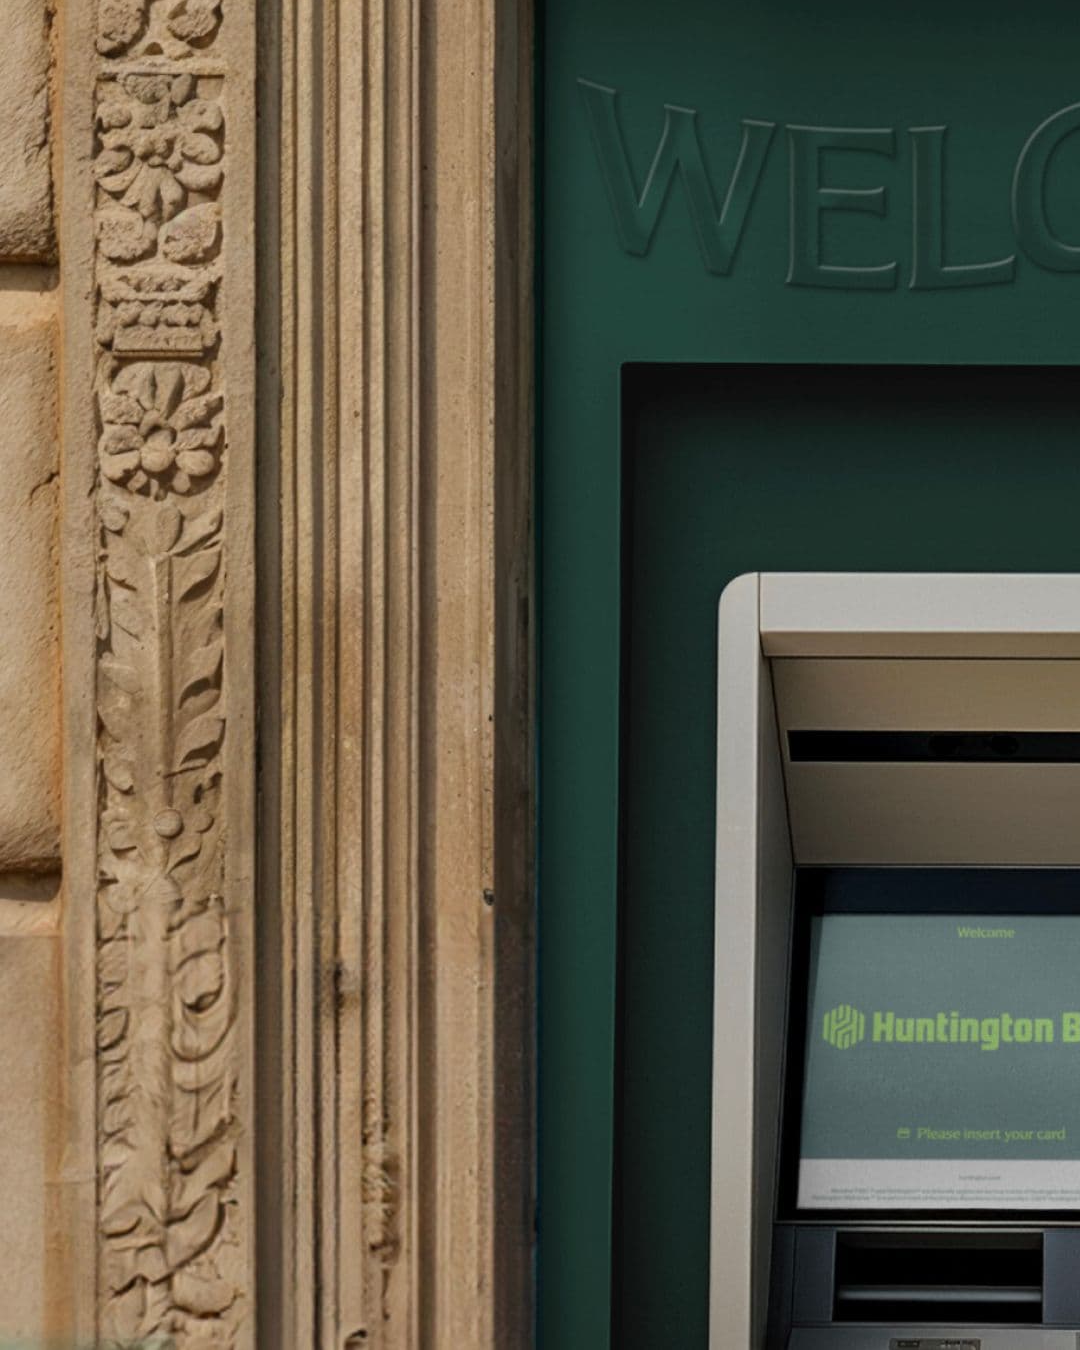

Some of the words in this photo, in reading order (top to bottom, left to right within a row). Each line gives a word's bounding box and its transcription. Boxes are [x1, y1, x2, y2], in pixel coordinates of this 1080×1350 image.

[957, 926, 1016, 939] Welcome
[872, 1011, 1054, 1051] Huntington
[917, 1126, 961, 1140] Please
[964, 1127, 1000, 1140] insert
[1004, 1129, 1033, 1143] your
[1036, 1127, 1066, 1140] card
